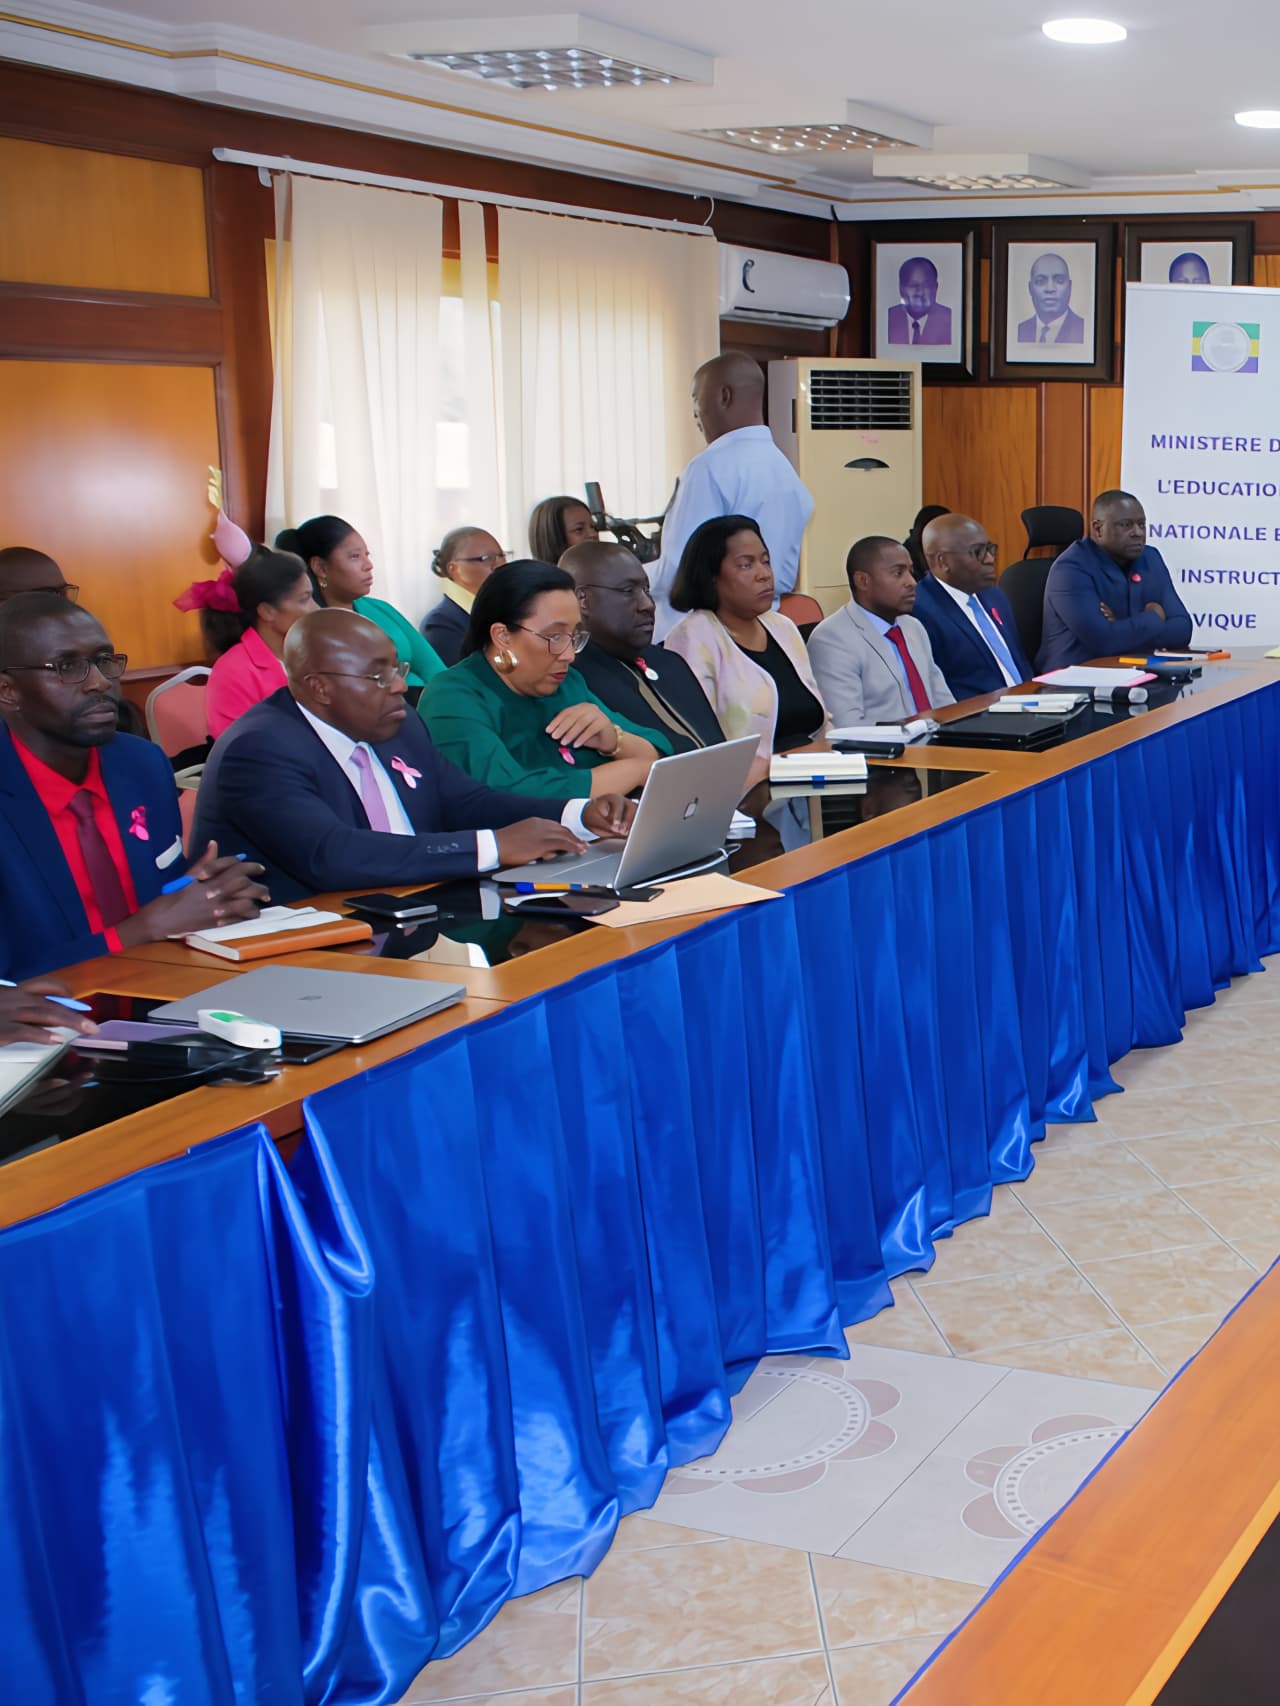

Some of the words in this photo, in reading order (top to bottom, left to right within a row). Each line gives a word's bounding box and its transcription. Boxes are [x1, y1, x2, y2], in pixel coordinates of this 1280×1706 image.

[1151, 434, 1262, 452] MINISTERE
[1149, 524, 1267, 541] NATIONALE
[1193, 613, 1257, 630] VIQUE
